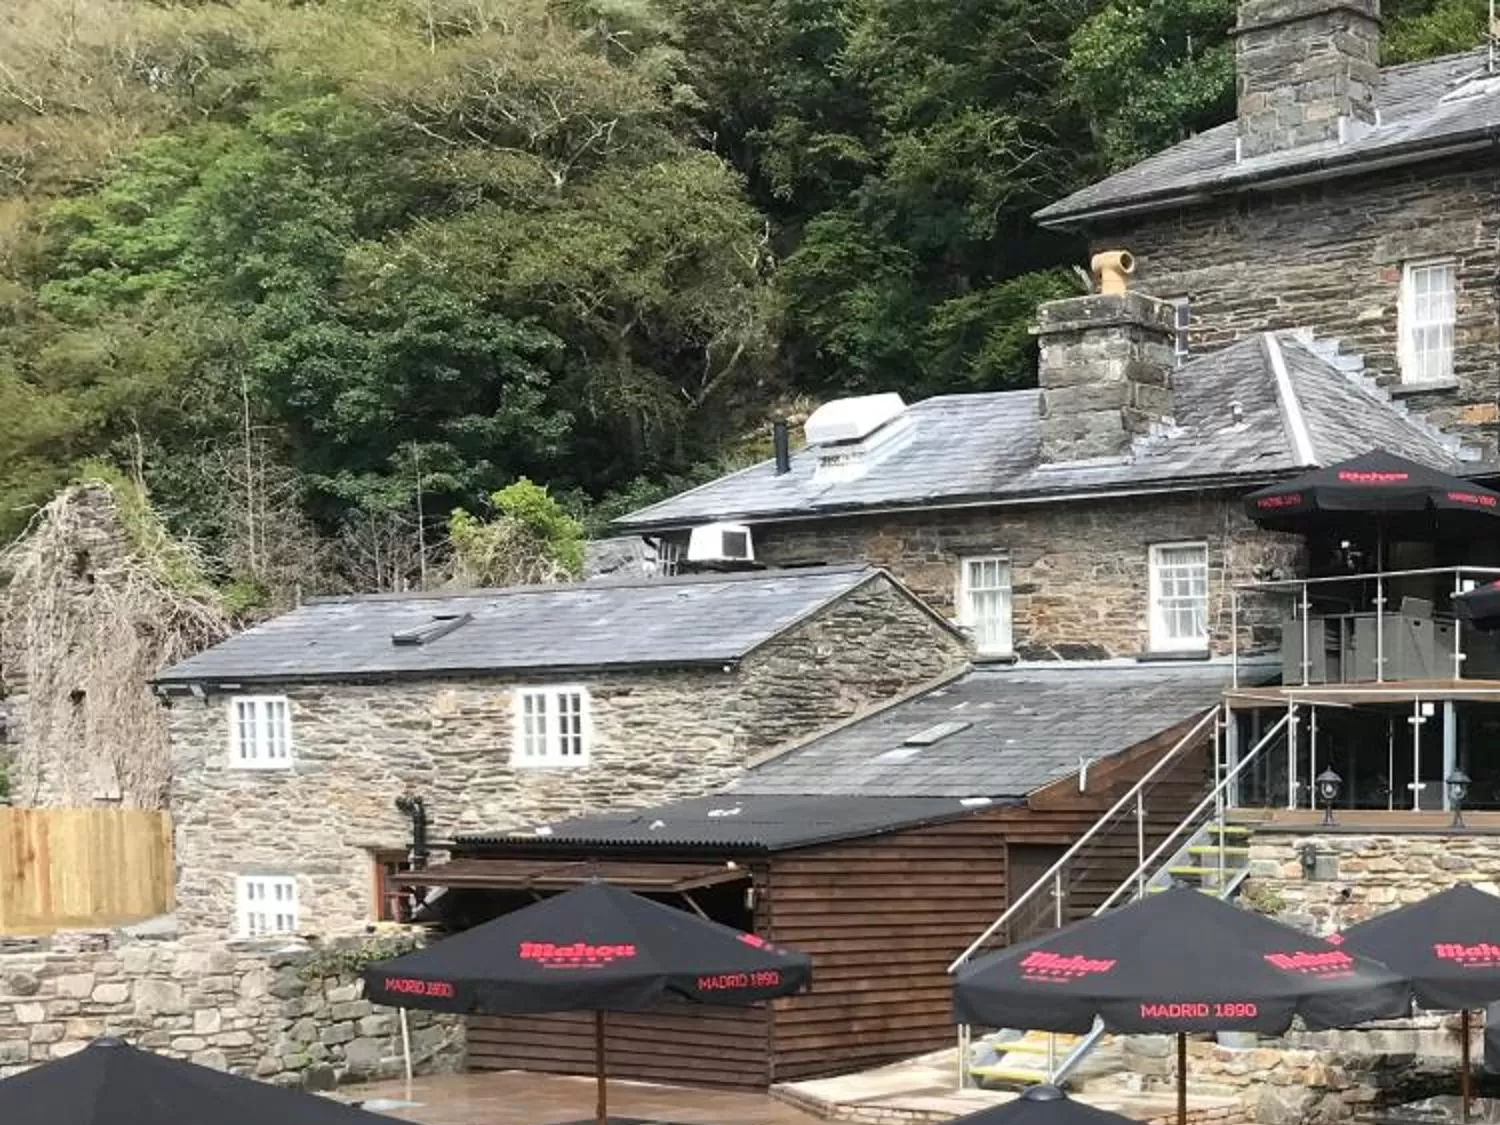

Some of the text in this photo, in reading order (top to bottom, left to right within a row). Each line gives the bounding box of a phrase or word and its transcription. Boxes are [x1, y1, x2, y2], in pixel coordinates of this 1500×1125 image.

[519, 942, 637, 959] Mahou
[1140, 1003, 1257, 1019] MADRID 1890
